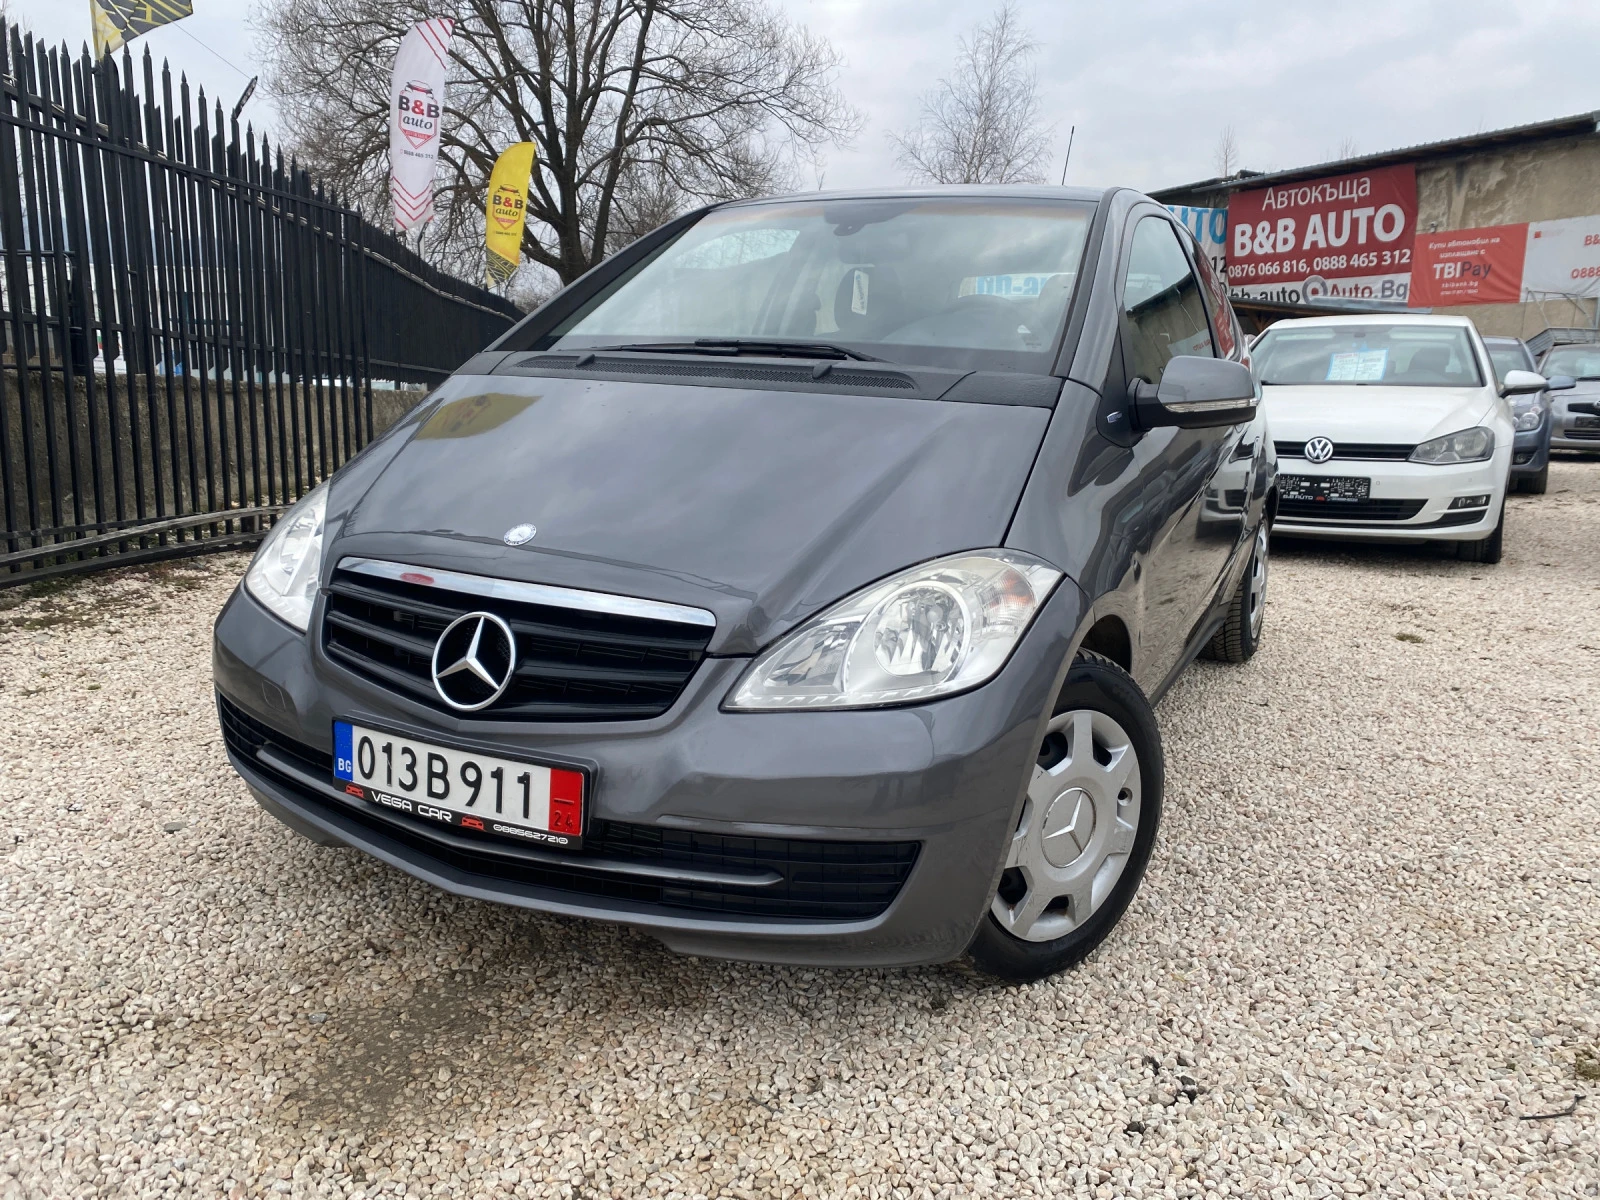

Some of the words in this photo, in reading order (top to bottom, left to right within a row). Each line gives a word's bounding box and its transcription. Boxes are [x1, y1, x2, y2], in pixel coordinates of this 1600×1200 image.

[398, 95, 440, 118] B&B
[402, 116, 433, 129] auto
[493, 195, 523, 209] B&B
[1262, 177, 1371, 211] Автокъща
[496, 208, 518, 216] auto
[1234, 217, 1296, 257] B&B
[1302, 203, 1406, 250] AUTO
[1228, 263, 1256, 278] 0876
[1258, 261, 1280, 275] 066
[1283, 258, 1311, 274] 816,
[1313, 254, 1347, 271] 0888
[1350, 252, 1378, 267] 465
[1381, 248, 1411, 265] 312
[1432, 261, 1492, 280] TBIPay
[338, 757, 352, 773] BG
[357, 735, 531, 820] 013B911
[371, 790, 412, 811] VEGA
[417, 805, 452, 822] CAR
